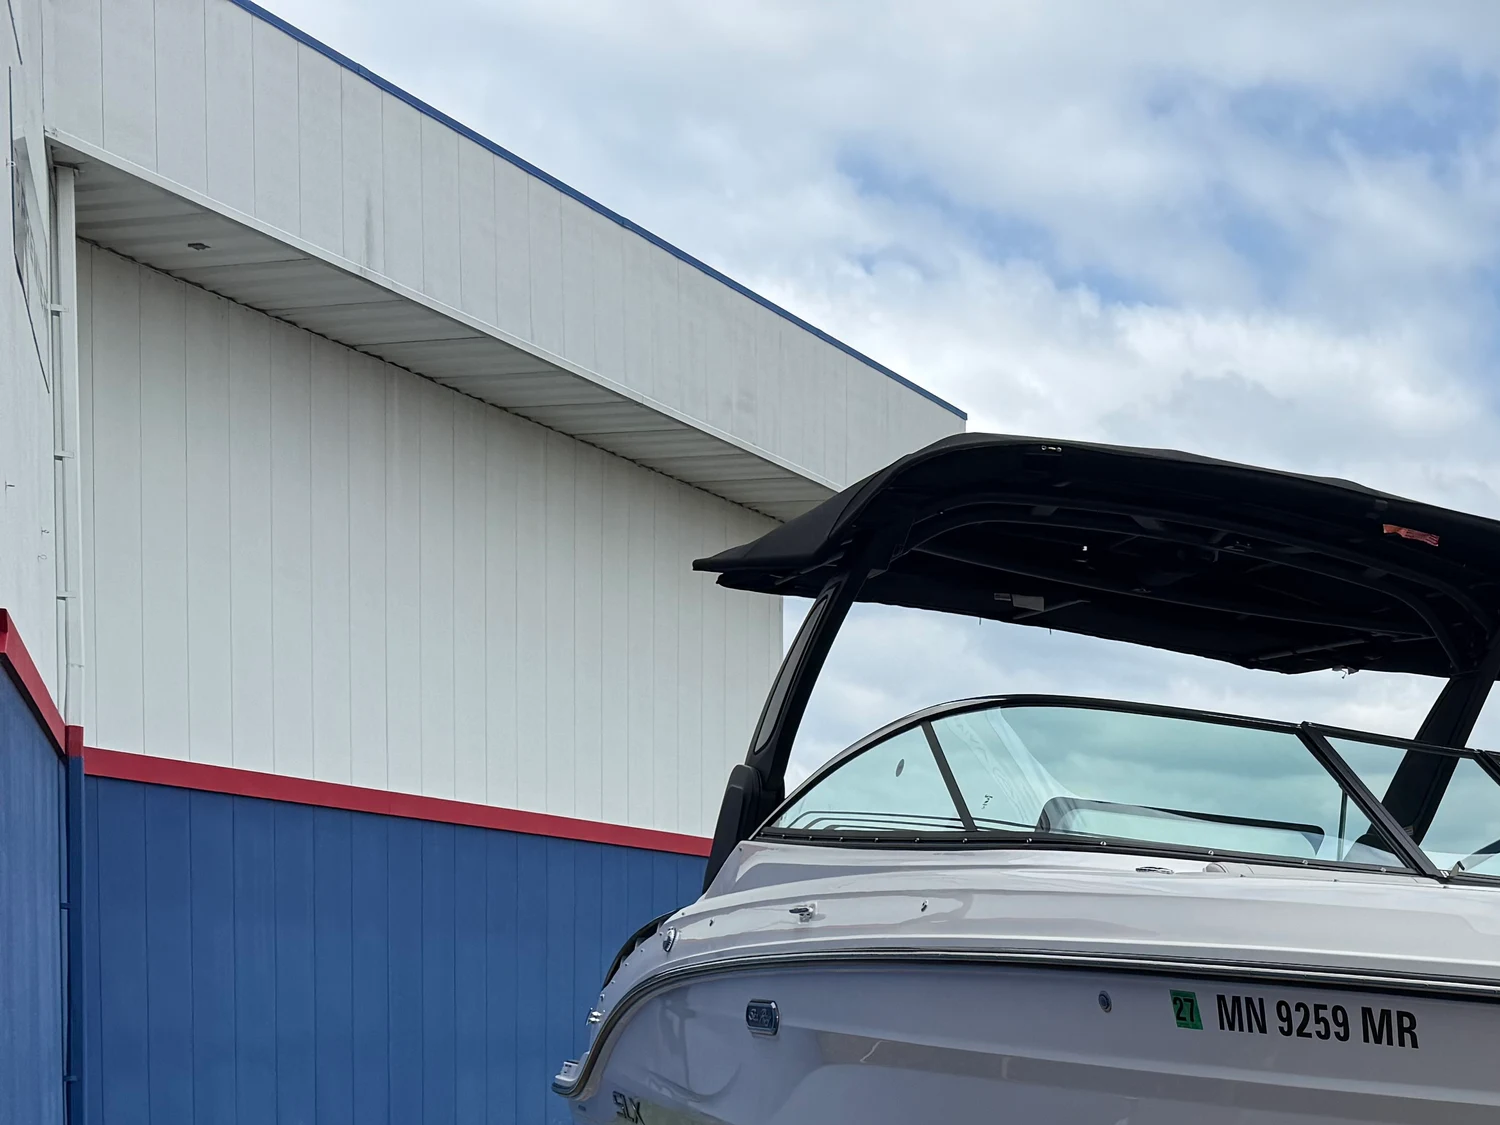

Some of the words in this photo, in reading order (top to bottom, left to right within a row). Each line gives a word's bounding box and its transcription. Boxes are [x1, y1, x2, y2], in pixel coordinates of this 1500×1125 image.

[1172, 996, 1196, 1023] 27
[1216, 993, 1268, 1035] MN
[1276, 999, 1350, 1042] 9259
[1361, 1006, 1420, 1049] MR
